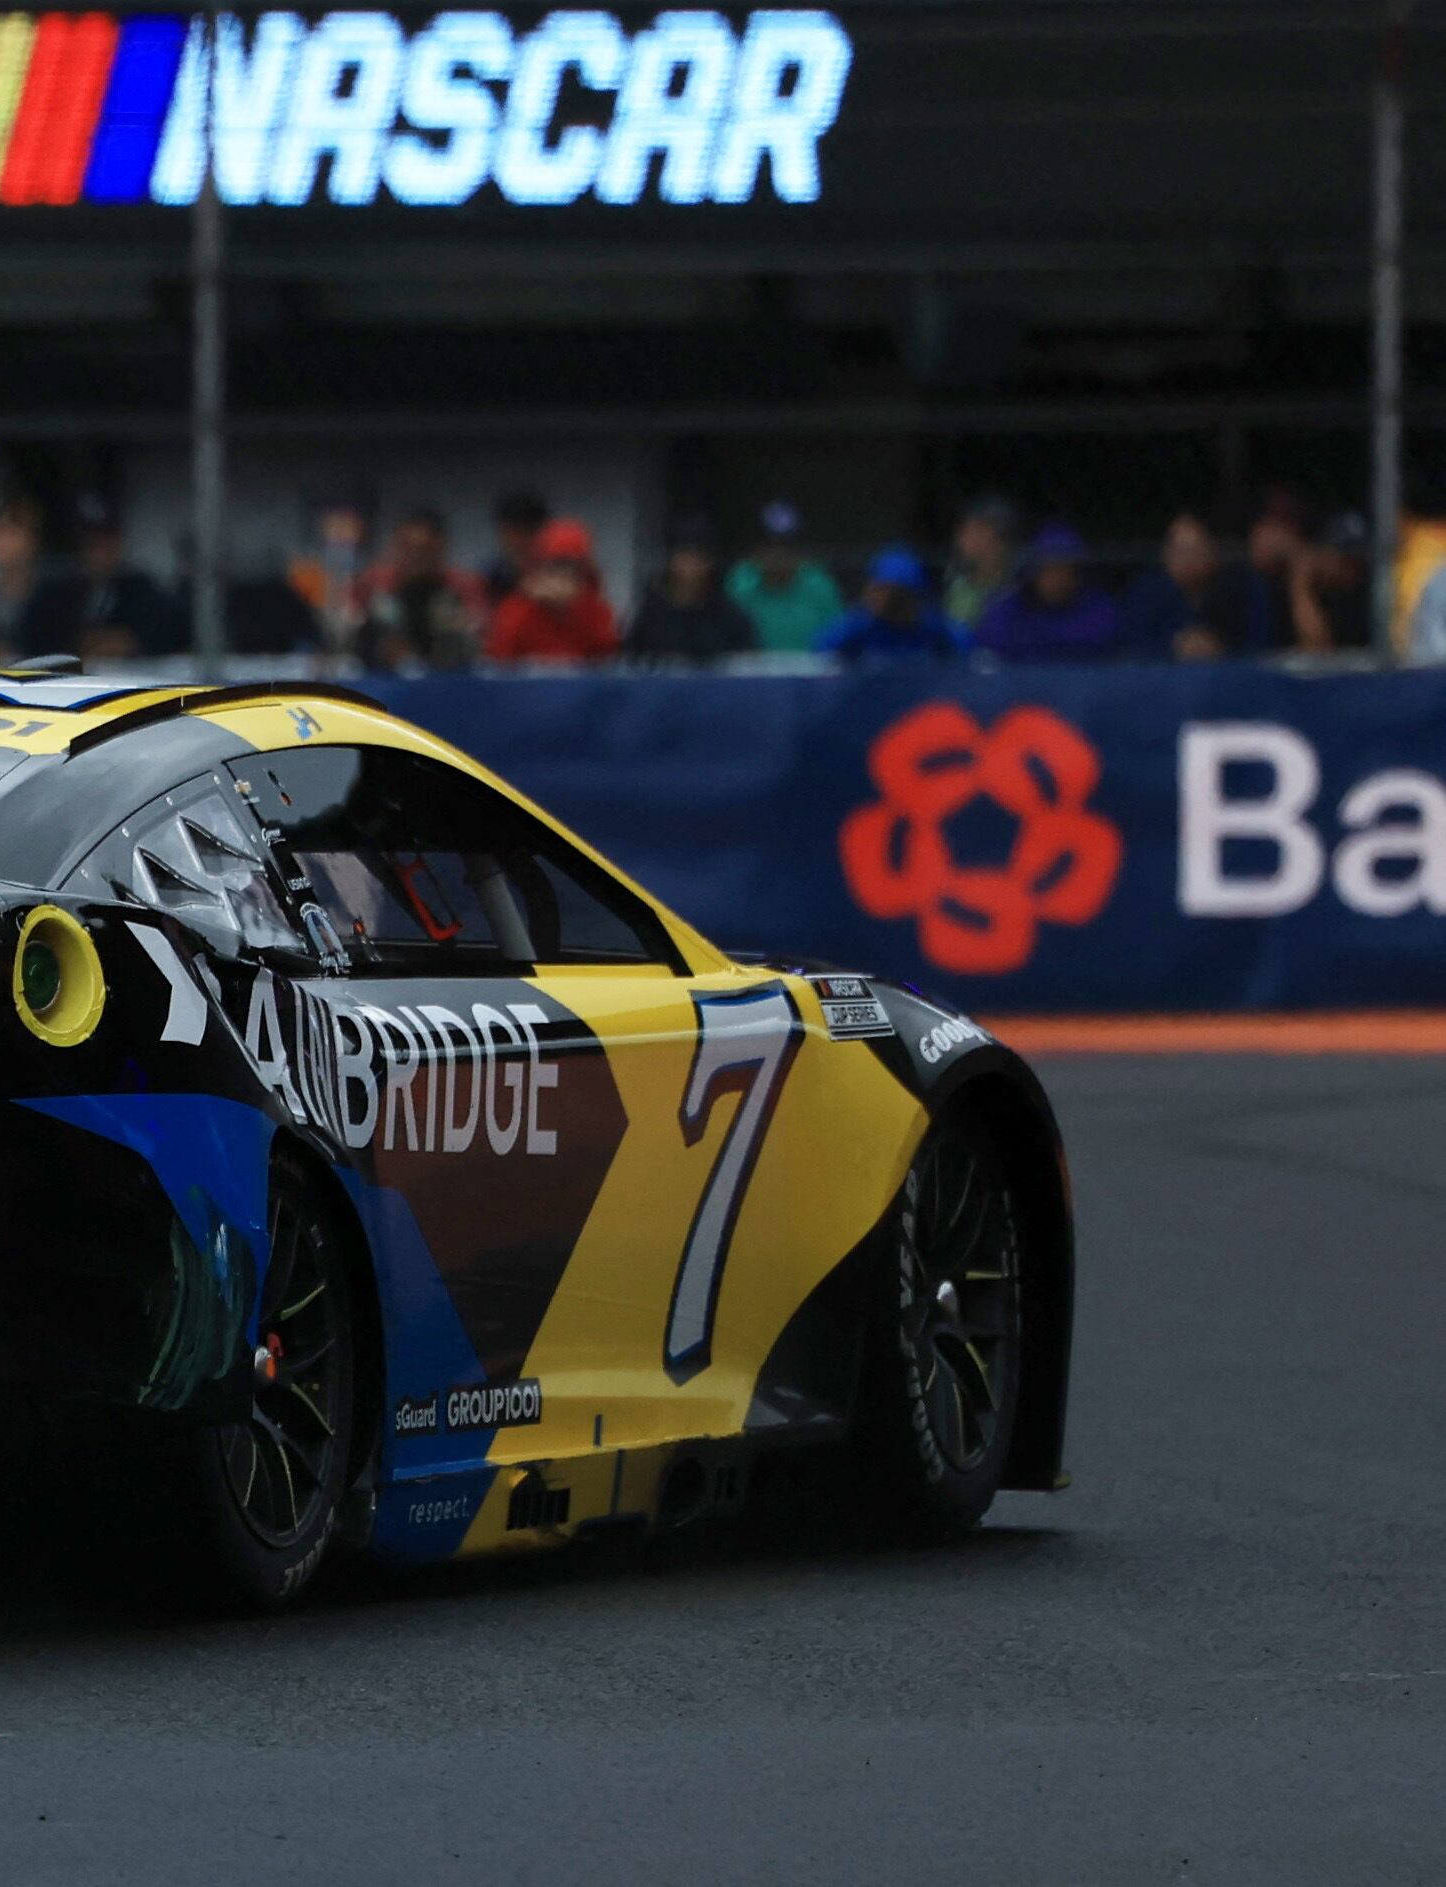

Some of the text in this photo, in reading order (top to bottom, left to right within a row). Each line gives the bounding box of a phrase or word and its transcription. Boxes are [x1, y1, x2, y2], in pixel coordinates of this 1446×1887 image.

[149, 9, 853, 206] NASCAR
[664, 979, 807, 1388] 7
[447, 1384, 541, 1428] GROUP1001
